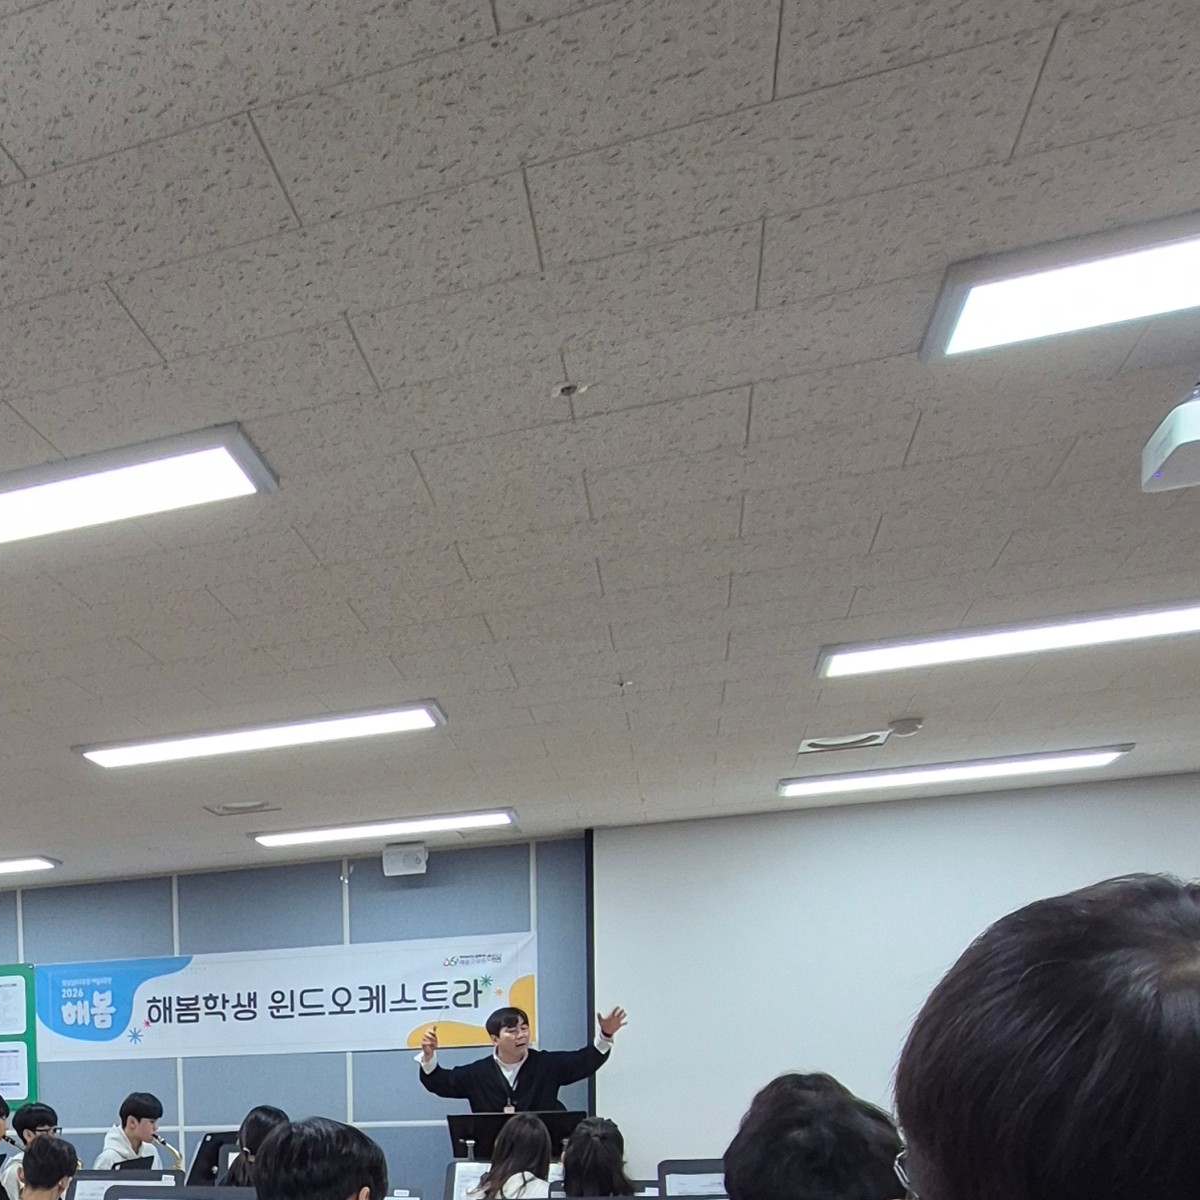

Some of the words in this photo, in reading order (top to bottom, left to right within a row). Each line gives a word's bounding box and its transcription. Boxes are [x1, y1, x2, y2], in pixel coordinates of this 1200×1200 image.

[61, 990, 117, 1029] 해봄
[62, 988, 84, 998] 2026
[146, 991, 258, 1024] 해봄학생
[268, 978, 483, 1019] 윈드오케스트라
